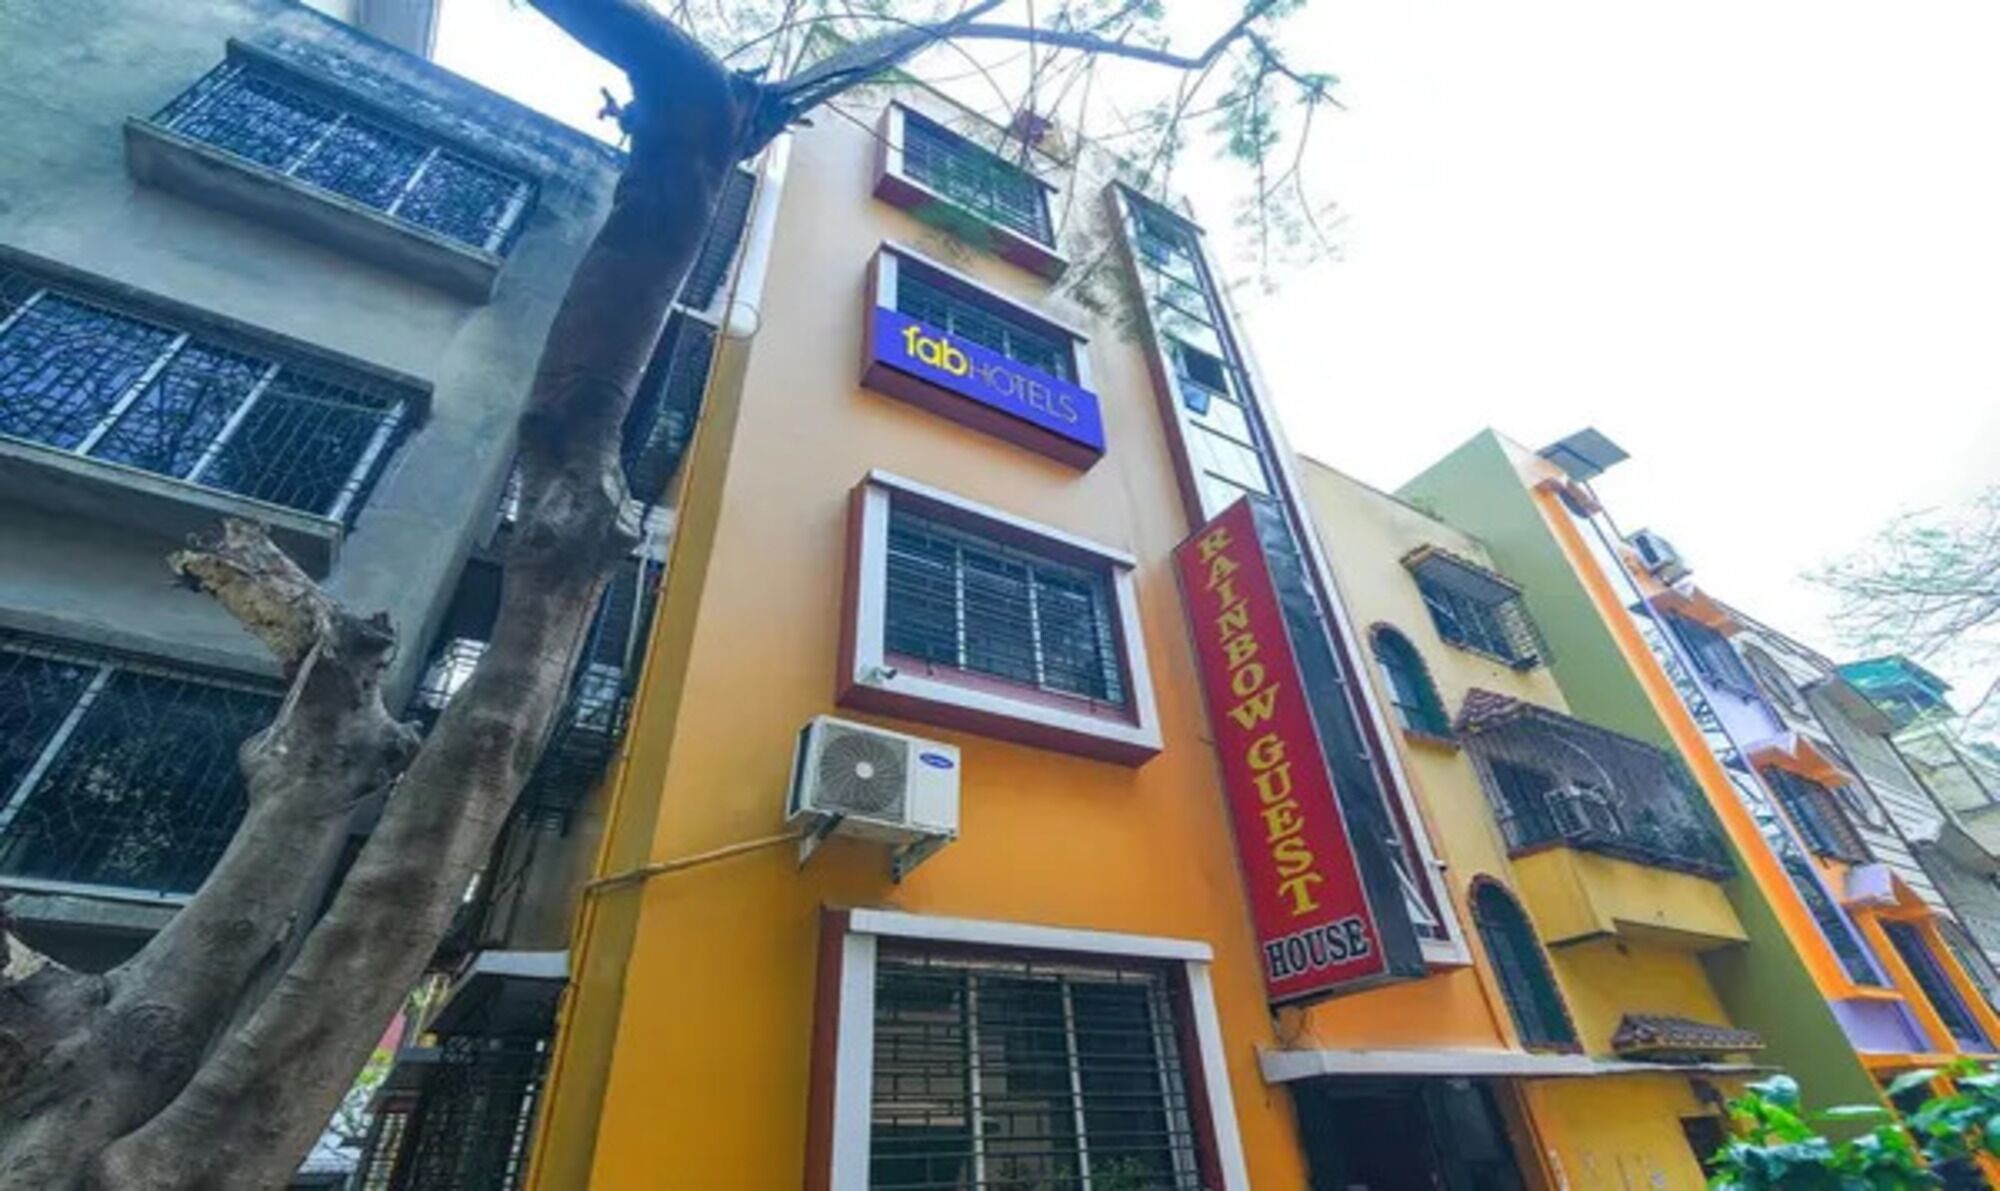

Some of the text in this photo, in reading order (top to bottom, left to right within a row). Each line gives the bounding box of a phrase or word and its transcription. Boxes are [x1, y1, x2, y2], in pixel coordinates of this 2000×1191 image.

[1198, 526, 1324, 916] RAINBOW GUEST
[1264, 916, 1370, 980] HOUSE
